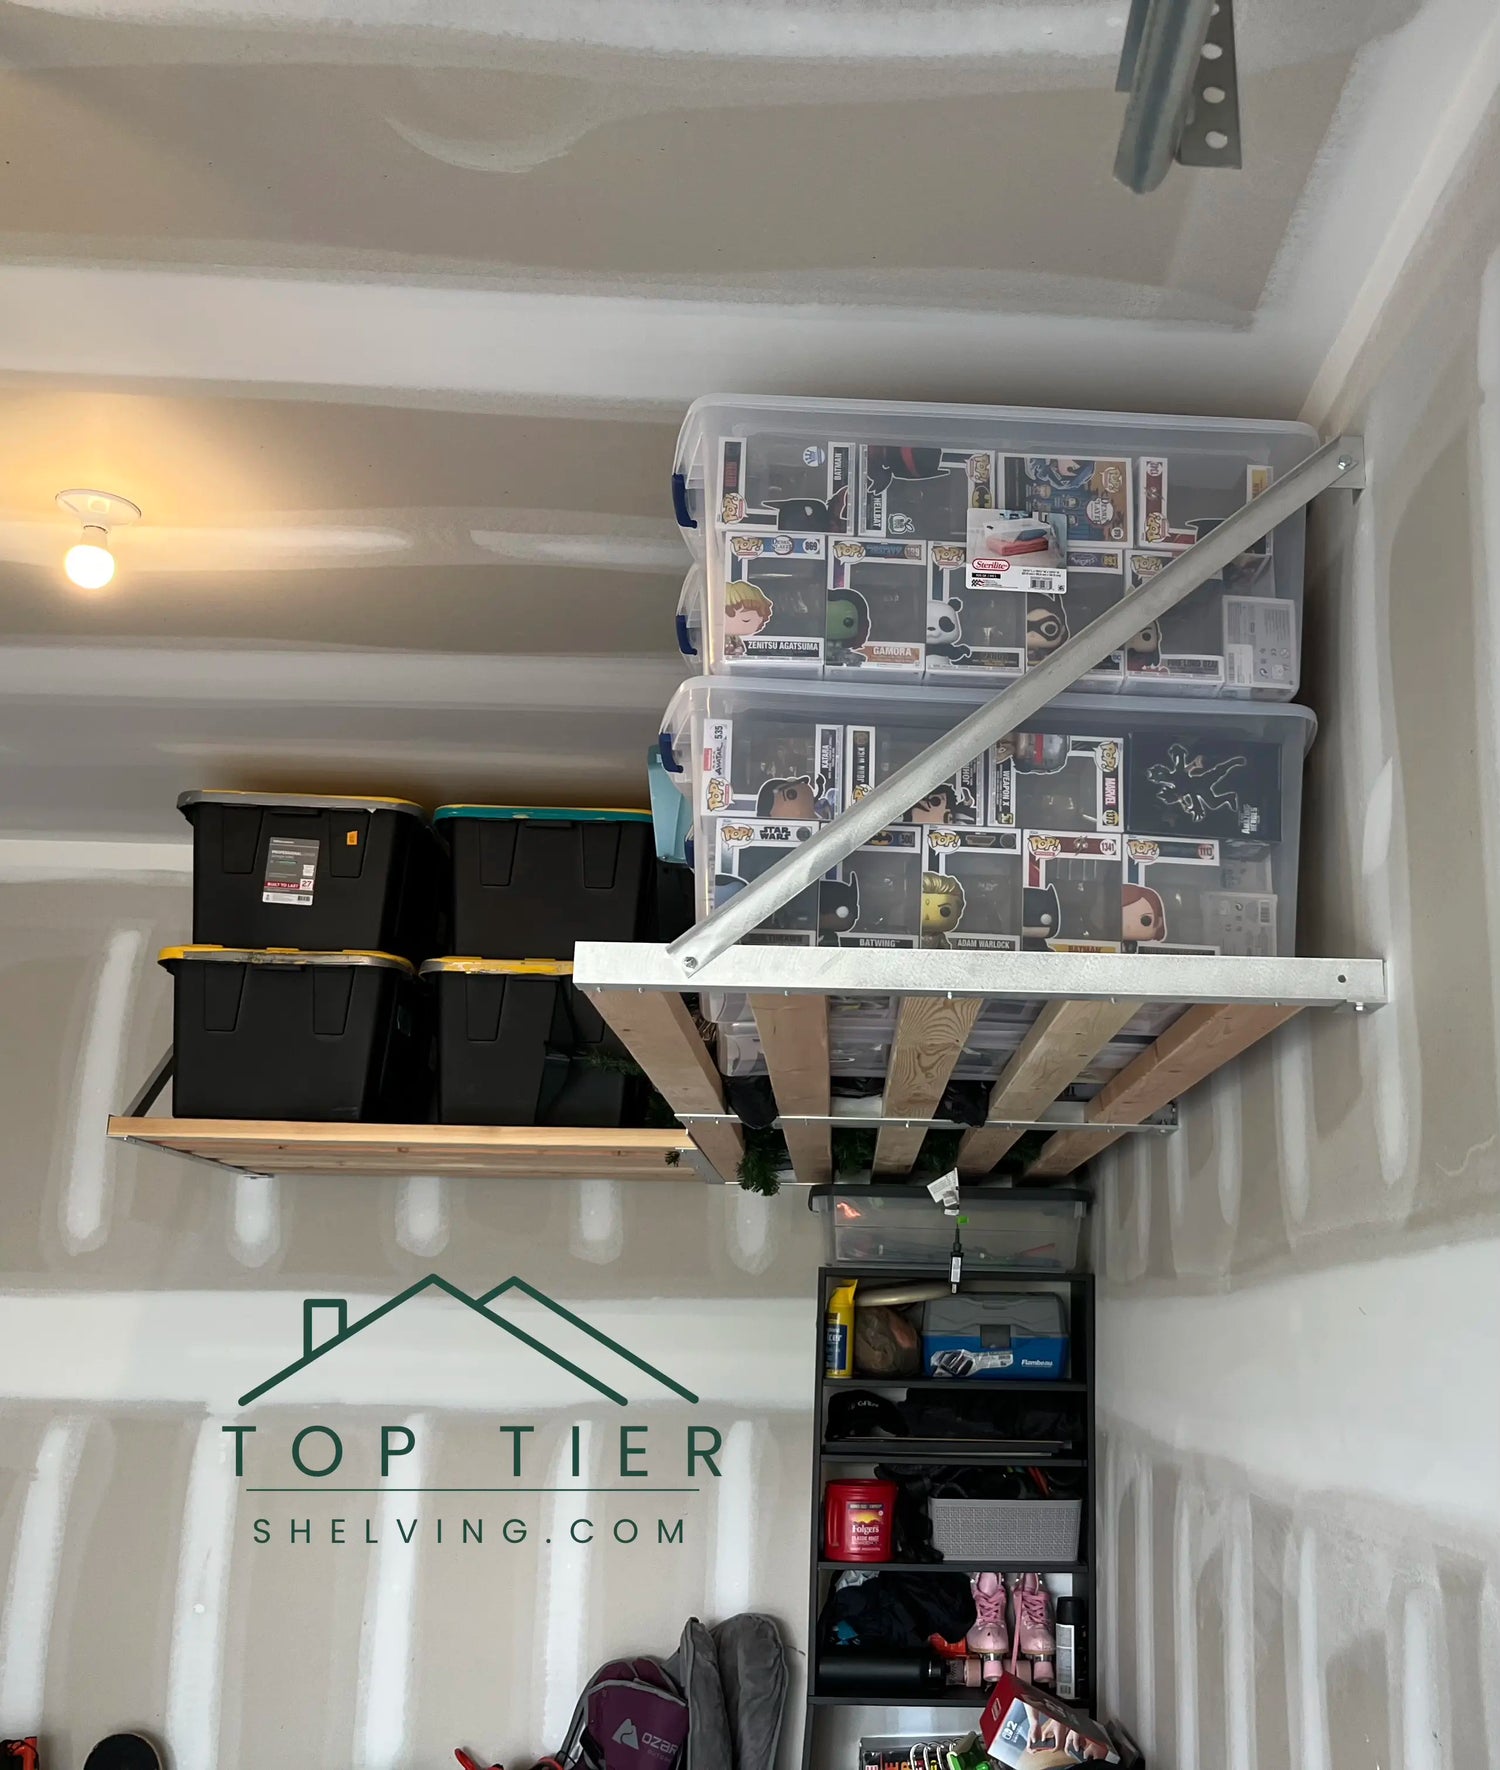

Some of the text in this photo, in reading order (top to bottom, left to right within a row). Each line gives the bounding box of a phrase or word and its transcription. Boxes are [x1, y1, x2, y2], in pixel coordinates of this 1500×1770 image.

[833, 452, 842, 481] BATMAN
[722, 493, 738, 524] POP!
[873, 498, 881, 528] HELLBAT
[1146, 512, 1161, 542] POP!
[730, 536, 762, 551] POP!
[805, 541, 818, 551] 869
[833, 542, 864, 558] POP!
[931, 546, 964, 561] POP!
[976, 561, 1006, 570] Sterilite
[1131, 555, 1162, 571] POP!
[748, 641, 818, 651] ZENITSU AGATSUMA
[873, 646, 912, 657] GAMORA
[715, 725, 723, 740] 535
[714, 742, 724, 775] AVATAR
[822, 745, 830, 769] KATARA
[856, 747, 865, 763] WICK
[1101, 743, 1118, 771] POP!
[856, 766, 865, 783] JOHN
[1002, 770, 1010, 800] WEAPON
[1105, 778, 1116, 805] MARVEL
[707, 778, 724, 811] POP!
[721, 825, 754, 841] POP!
[928, 832, 959, 847] POP!
[1027, 836, 1059, 851] POP!
[1127, 840, 1158, 855] POP!
[859, 939, 896, 947] BATWING
[957, 939, 1010, 949] ADAM WARLOCK
[1021, 1359, 1053, 1367] Flambeau
[852, 1524, 880, 1535] Folgers
